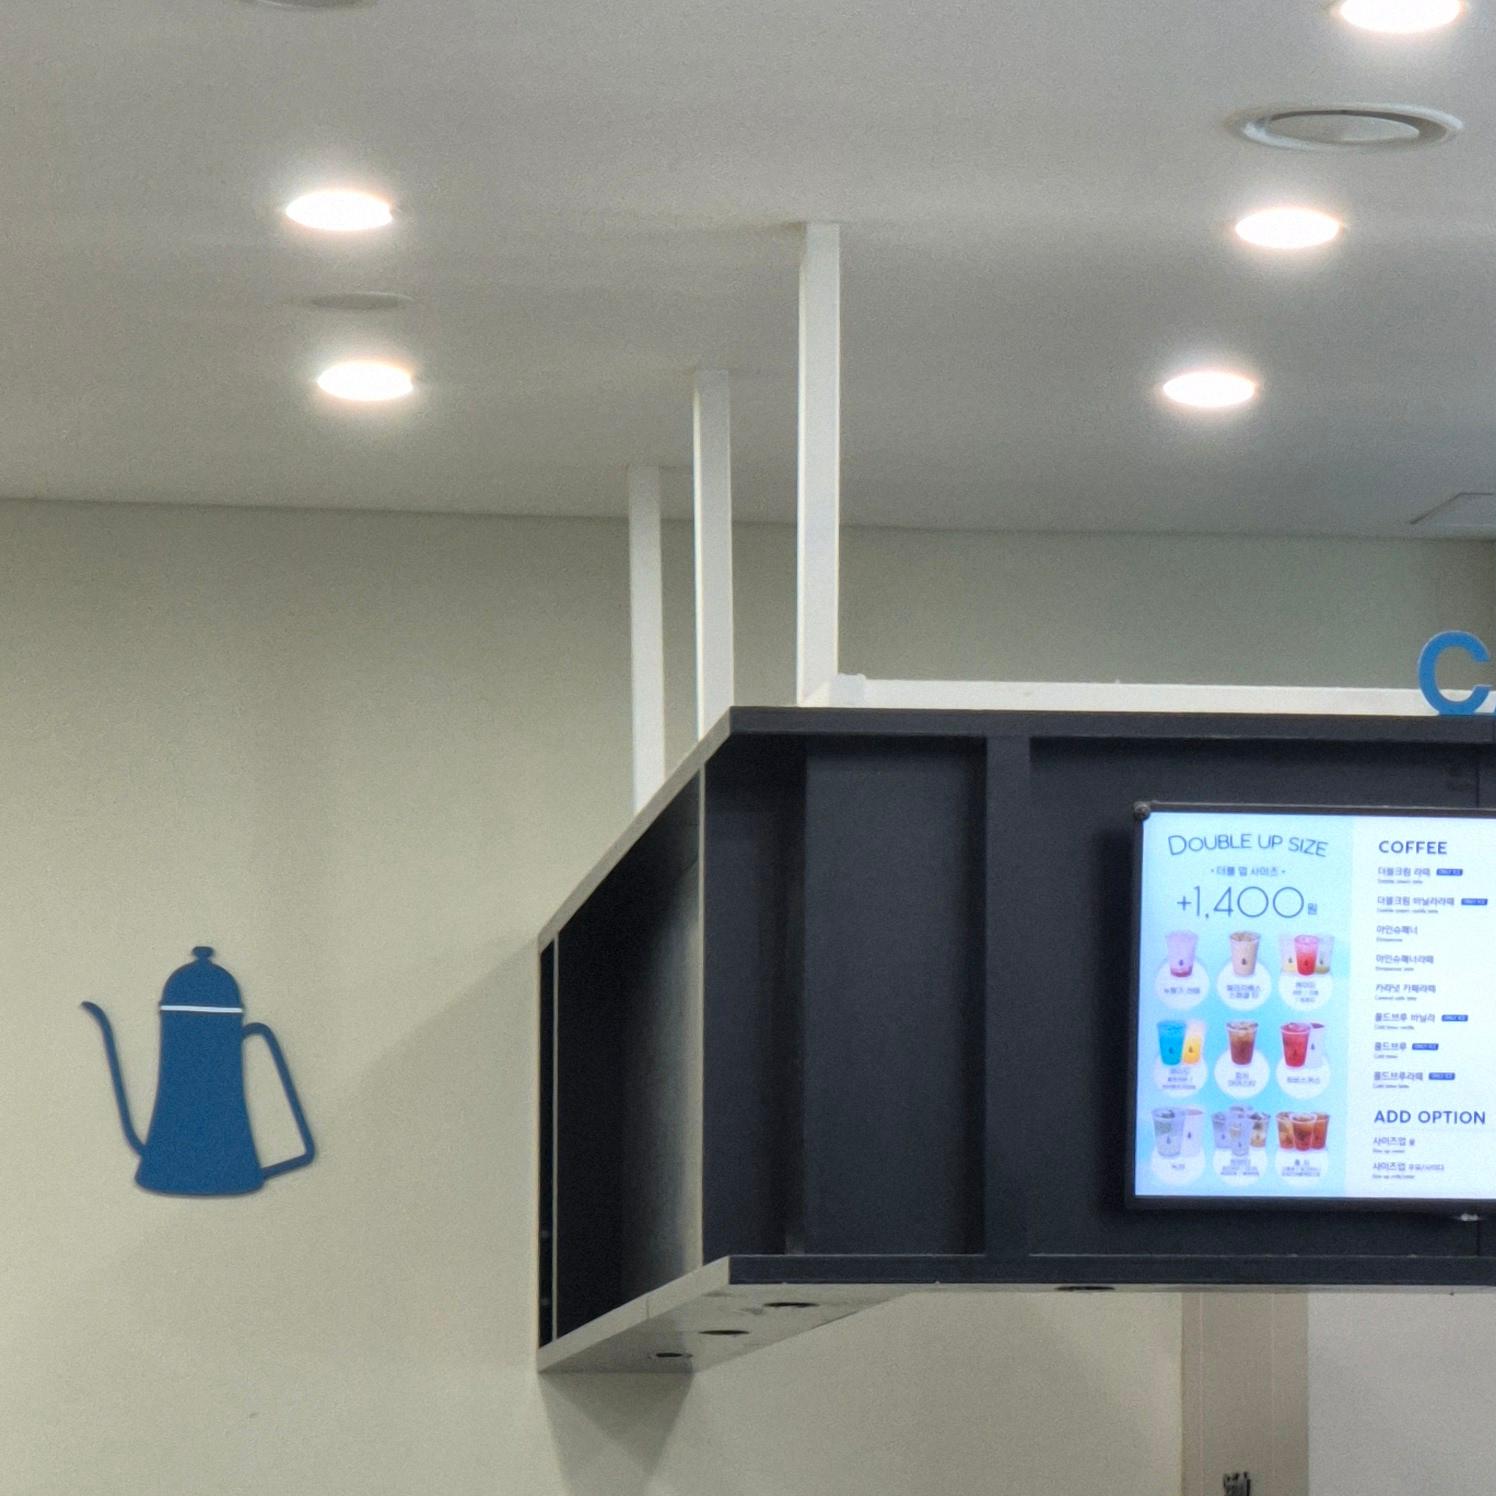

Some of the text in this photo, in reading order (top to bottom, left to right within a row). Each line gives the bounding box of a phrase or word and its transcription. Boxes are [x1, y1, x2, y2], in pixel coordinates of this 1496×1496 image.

[1168, 833, 1329, 858] DOUBLE UP SIZE
[1378, 840, 1448, 855] COFFEE
[1374, 1109, 1487, 1125] ADD OPTION
[1372, 1136, 1407, 1147] 사이즈업
[1372, 1162, 1407, 1172] 사이즈업
